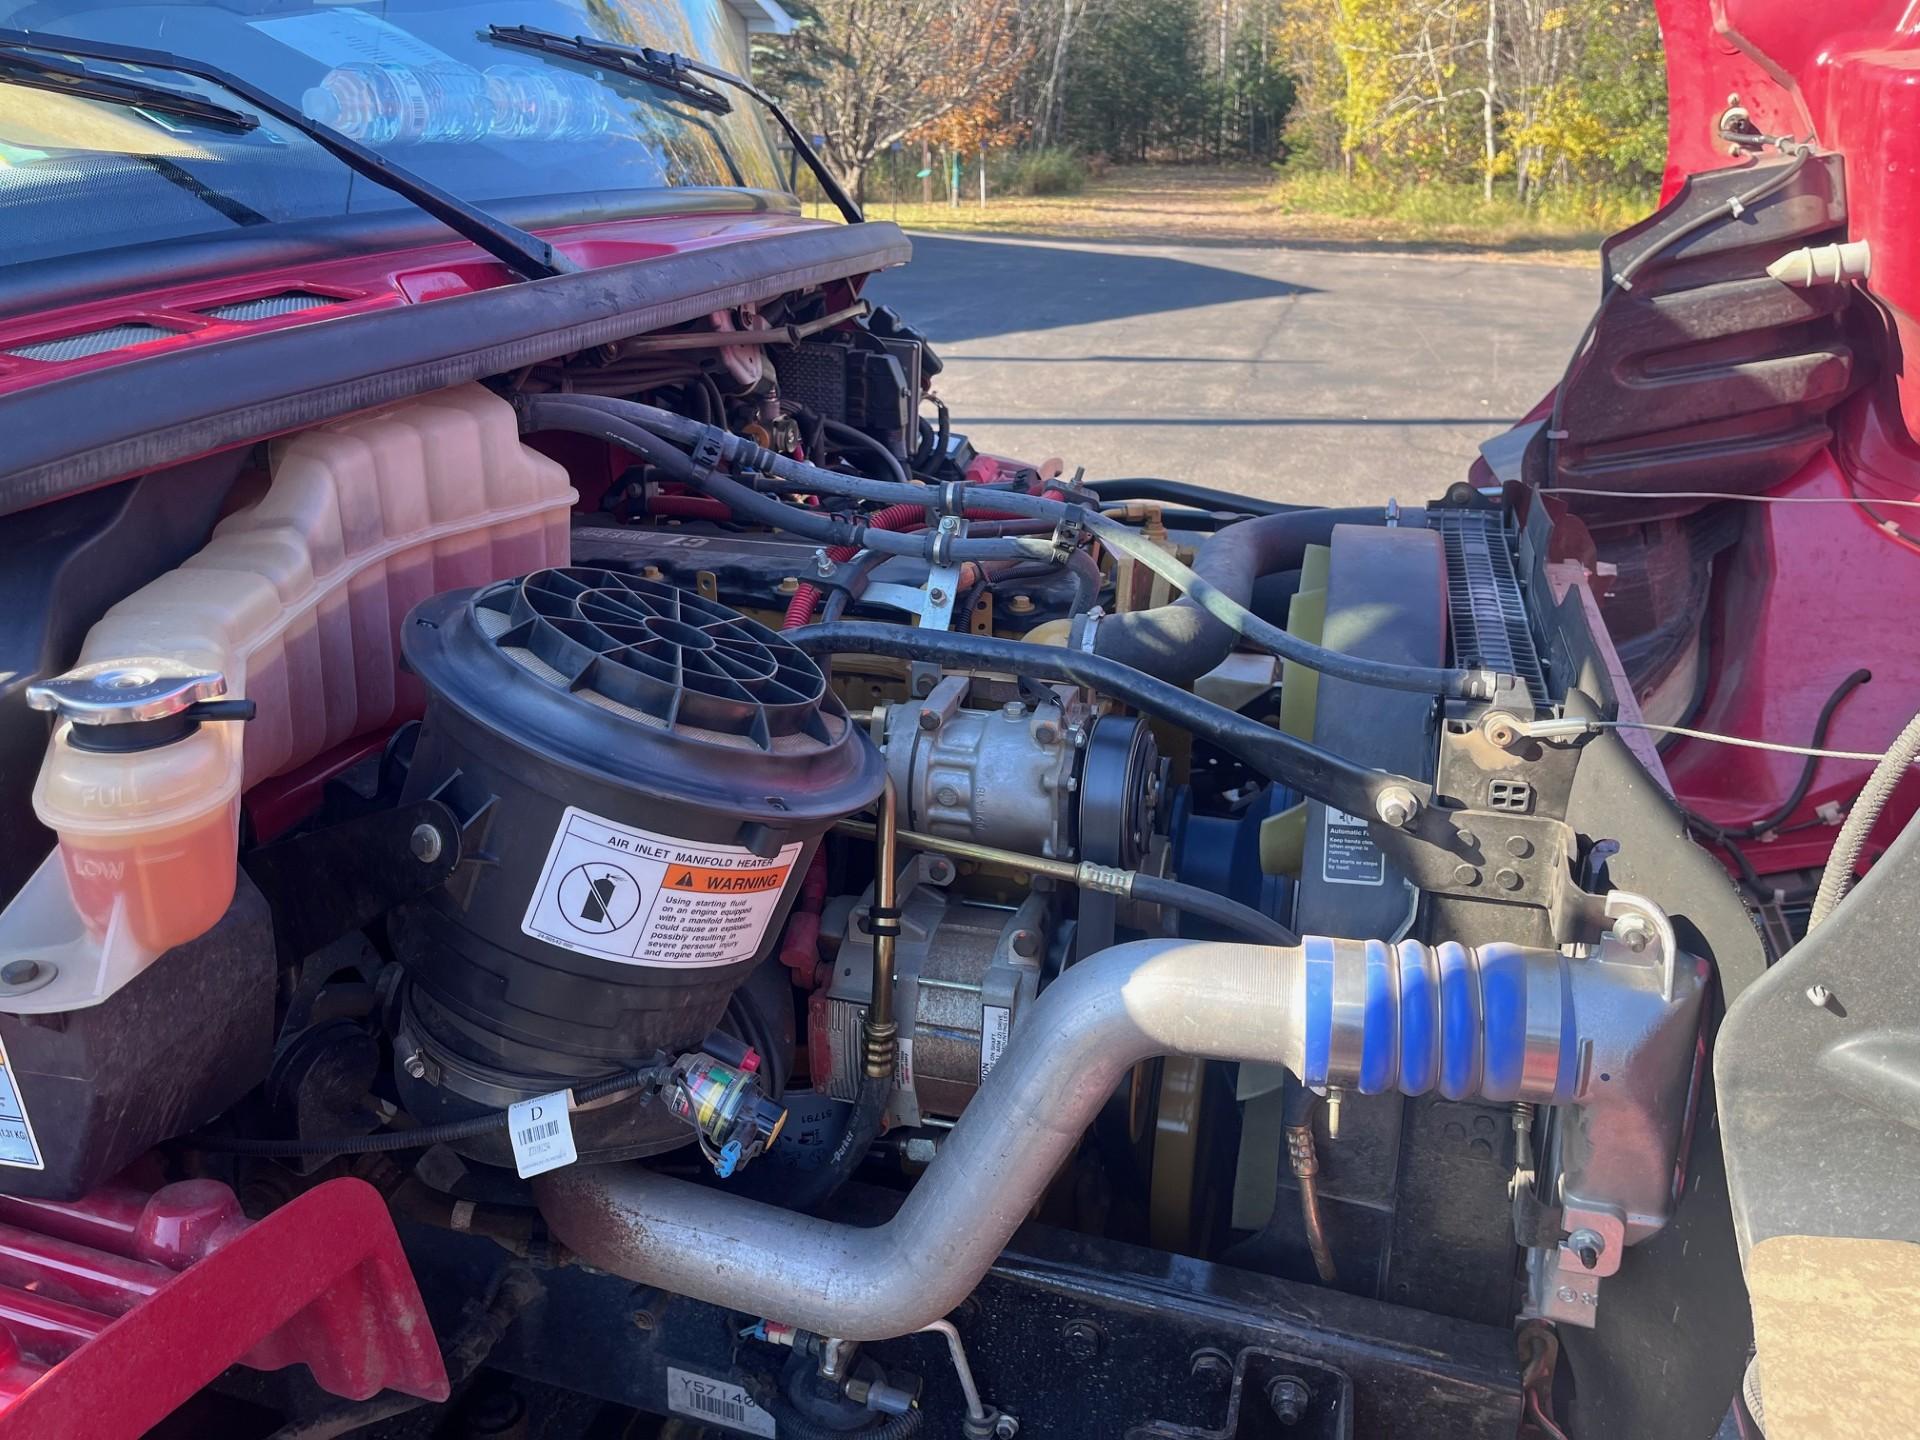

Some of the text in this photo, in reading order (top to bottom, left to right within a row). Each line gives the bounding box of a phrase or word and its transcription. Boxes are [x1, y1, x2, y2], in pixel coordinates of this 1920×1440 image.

[81, 785, 150, 808] FULL
[1330, 828, 1362, 836] Automatic
[608, 836, 774, 868] AIR INLET MANIFOLD HEATER
[72, 852, 125, 880] LOW
[707, 874, 778, 890] WARNING
[665, 896, 691, 907] Using
[696, 899, 726, 908] starting
[691, 909, 718, 917] engine
[720, 906, 752, 916] equipped
[659, 914, 676, 922] with
[725, 916, 747, 924] heater
[655, 923, 679, 931] could
[650, 932, 689, 942] possibly
[692, 933, 726, 942] resulting
[648, 941, 739, 950] severe personal injury
[664, 950, 692, 959] engine
[695, 950, 724, 958] damage
[531, 1106, 543, 1121] D
[830, 1130, 854, 1164] Parker
[682, 1378, 755, 1408] Y57140
